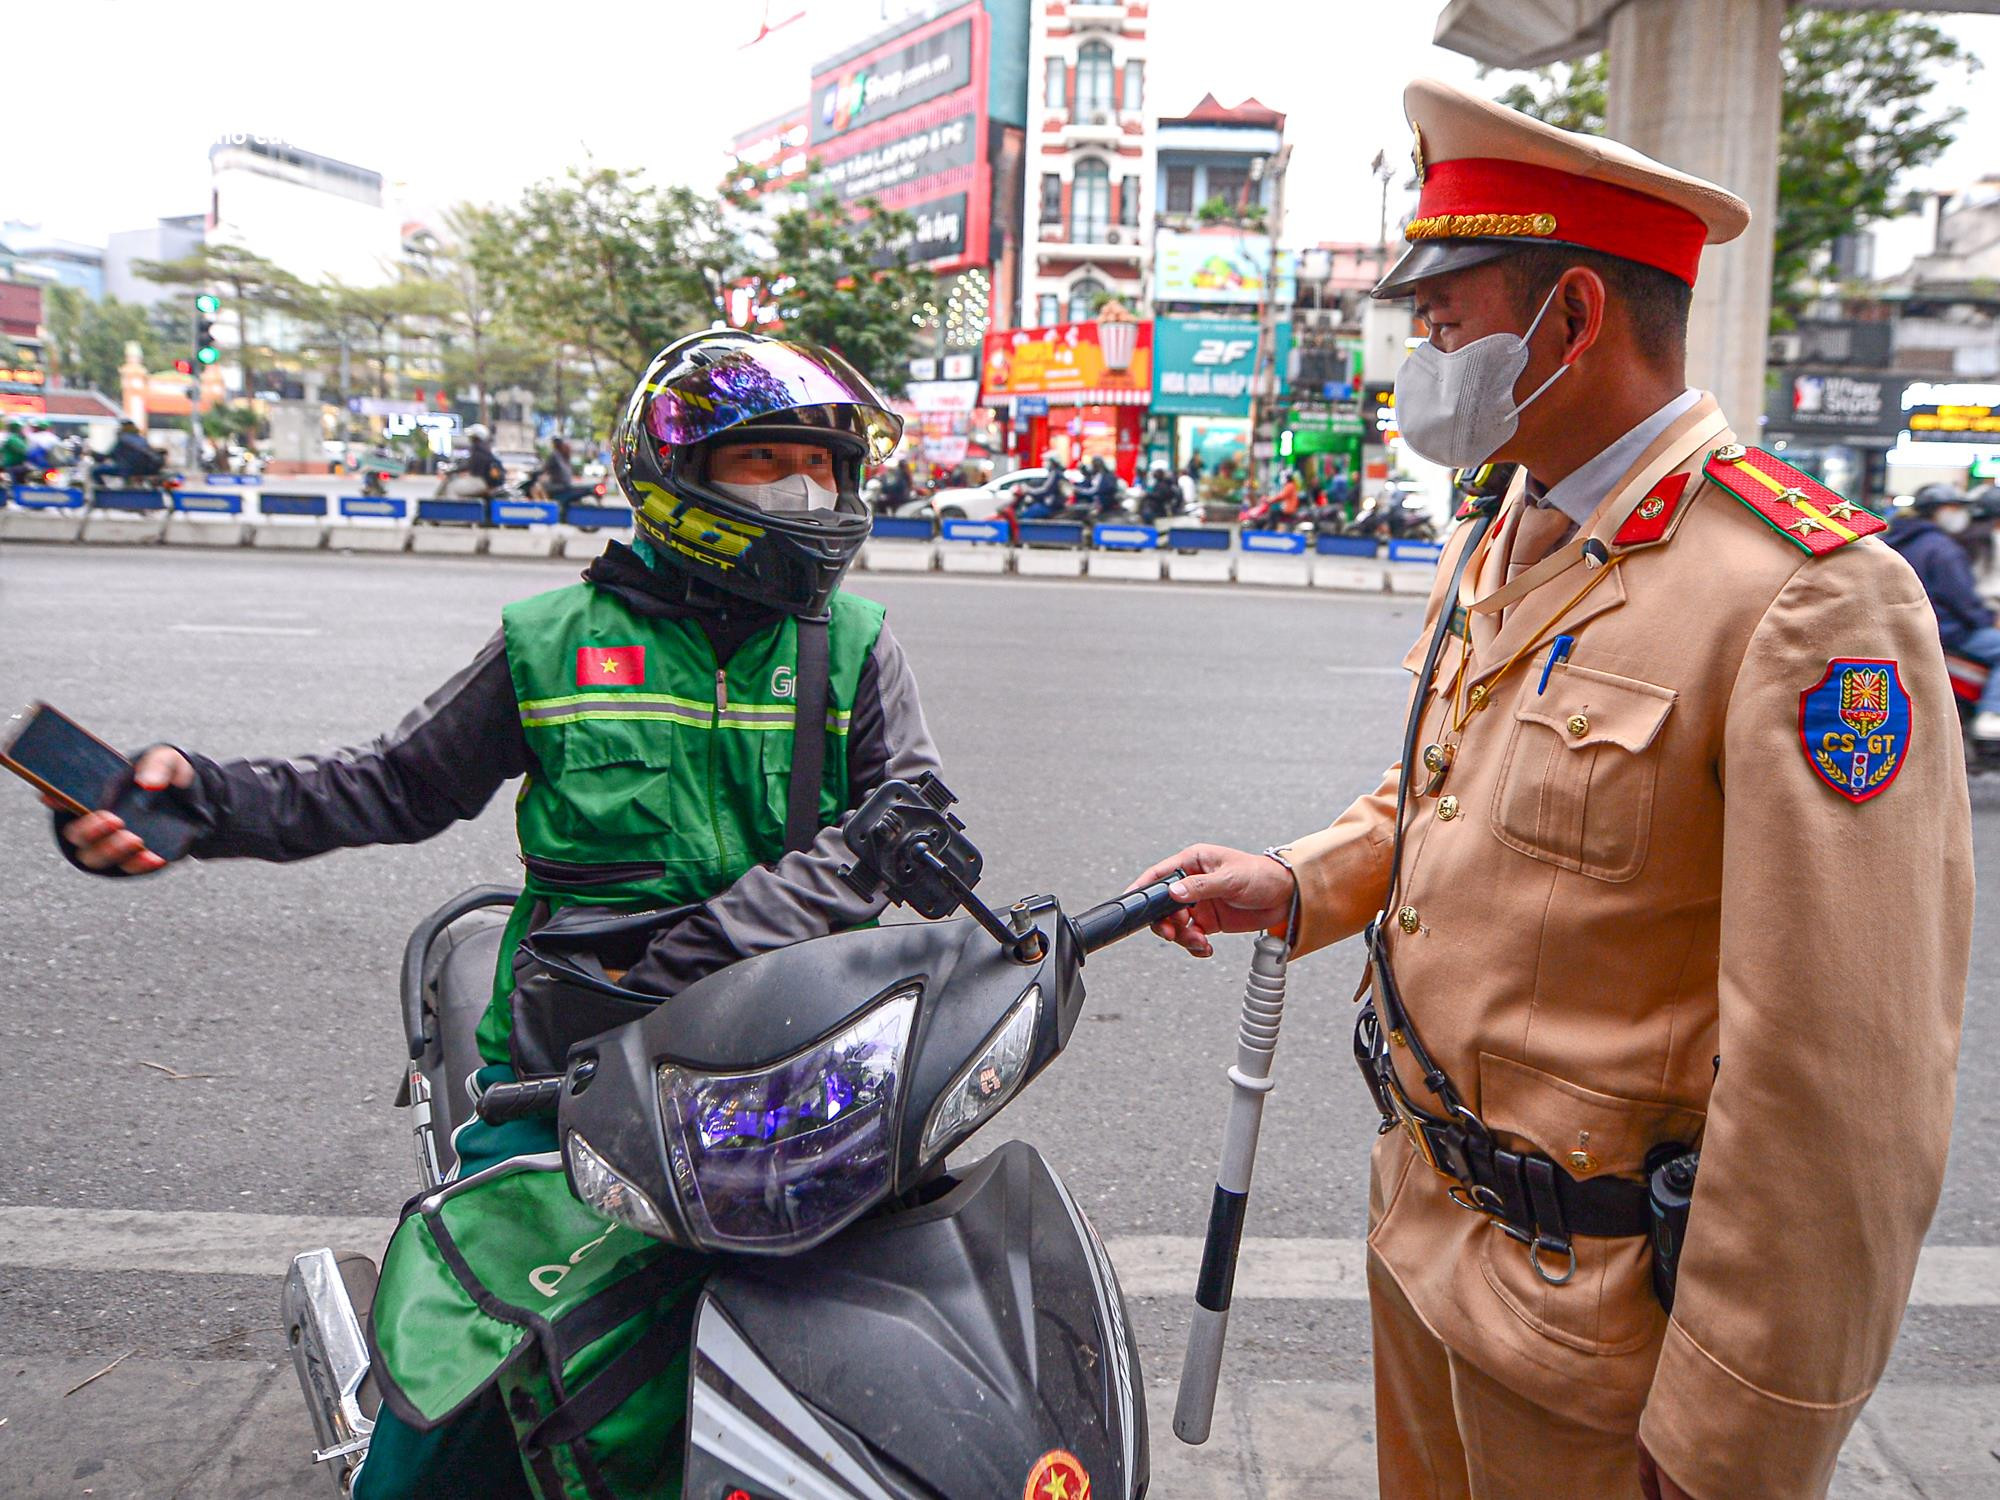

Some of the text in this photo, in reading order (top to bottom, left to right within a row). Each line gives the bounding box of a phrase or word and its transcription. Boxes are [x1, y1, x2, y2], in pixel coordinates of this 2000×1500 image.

[1192, 339, 1254, 365] 2F
[1822, 732, 1896, 754] CS GT
